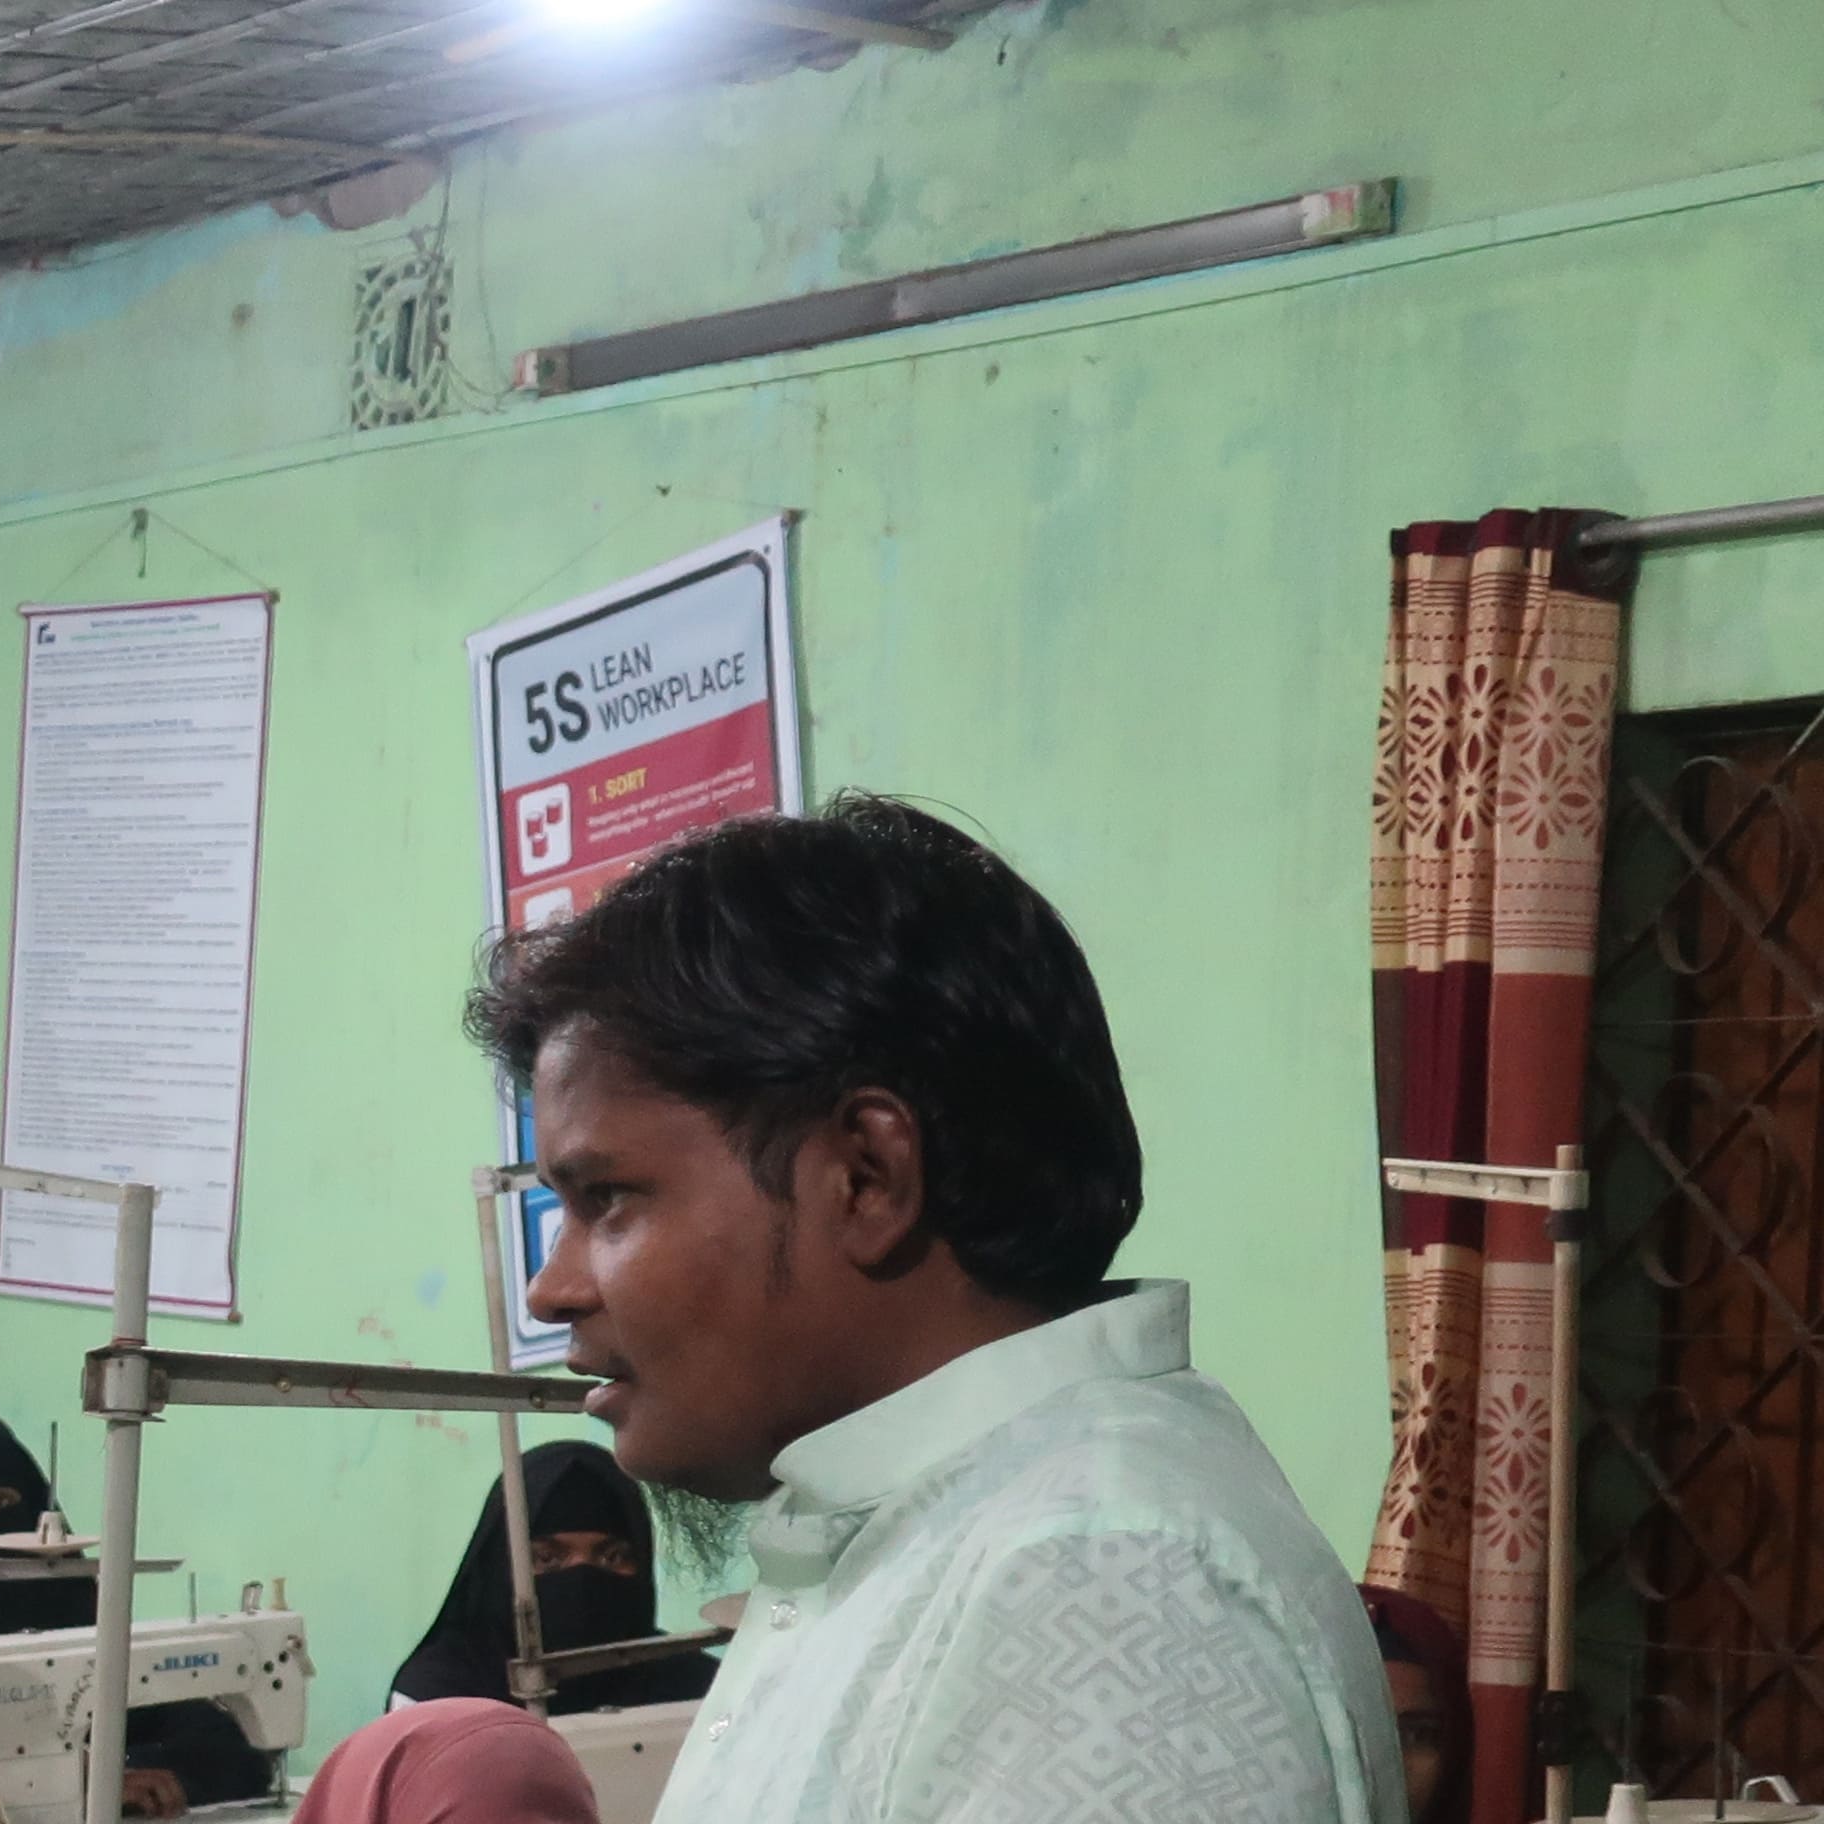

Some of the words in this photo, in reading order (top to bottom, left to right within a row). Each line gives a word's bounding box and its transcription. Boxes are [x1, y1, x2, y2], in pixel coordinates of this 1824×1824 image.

[591, 643, 652, 692] LEAN
[597, 651, 746, 732] WORKPLACE
[525, 671, 591, 754] 5S
[606, 767, 647, 799] SORT
[153, 1652, 220, 1672] JUKI
